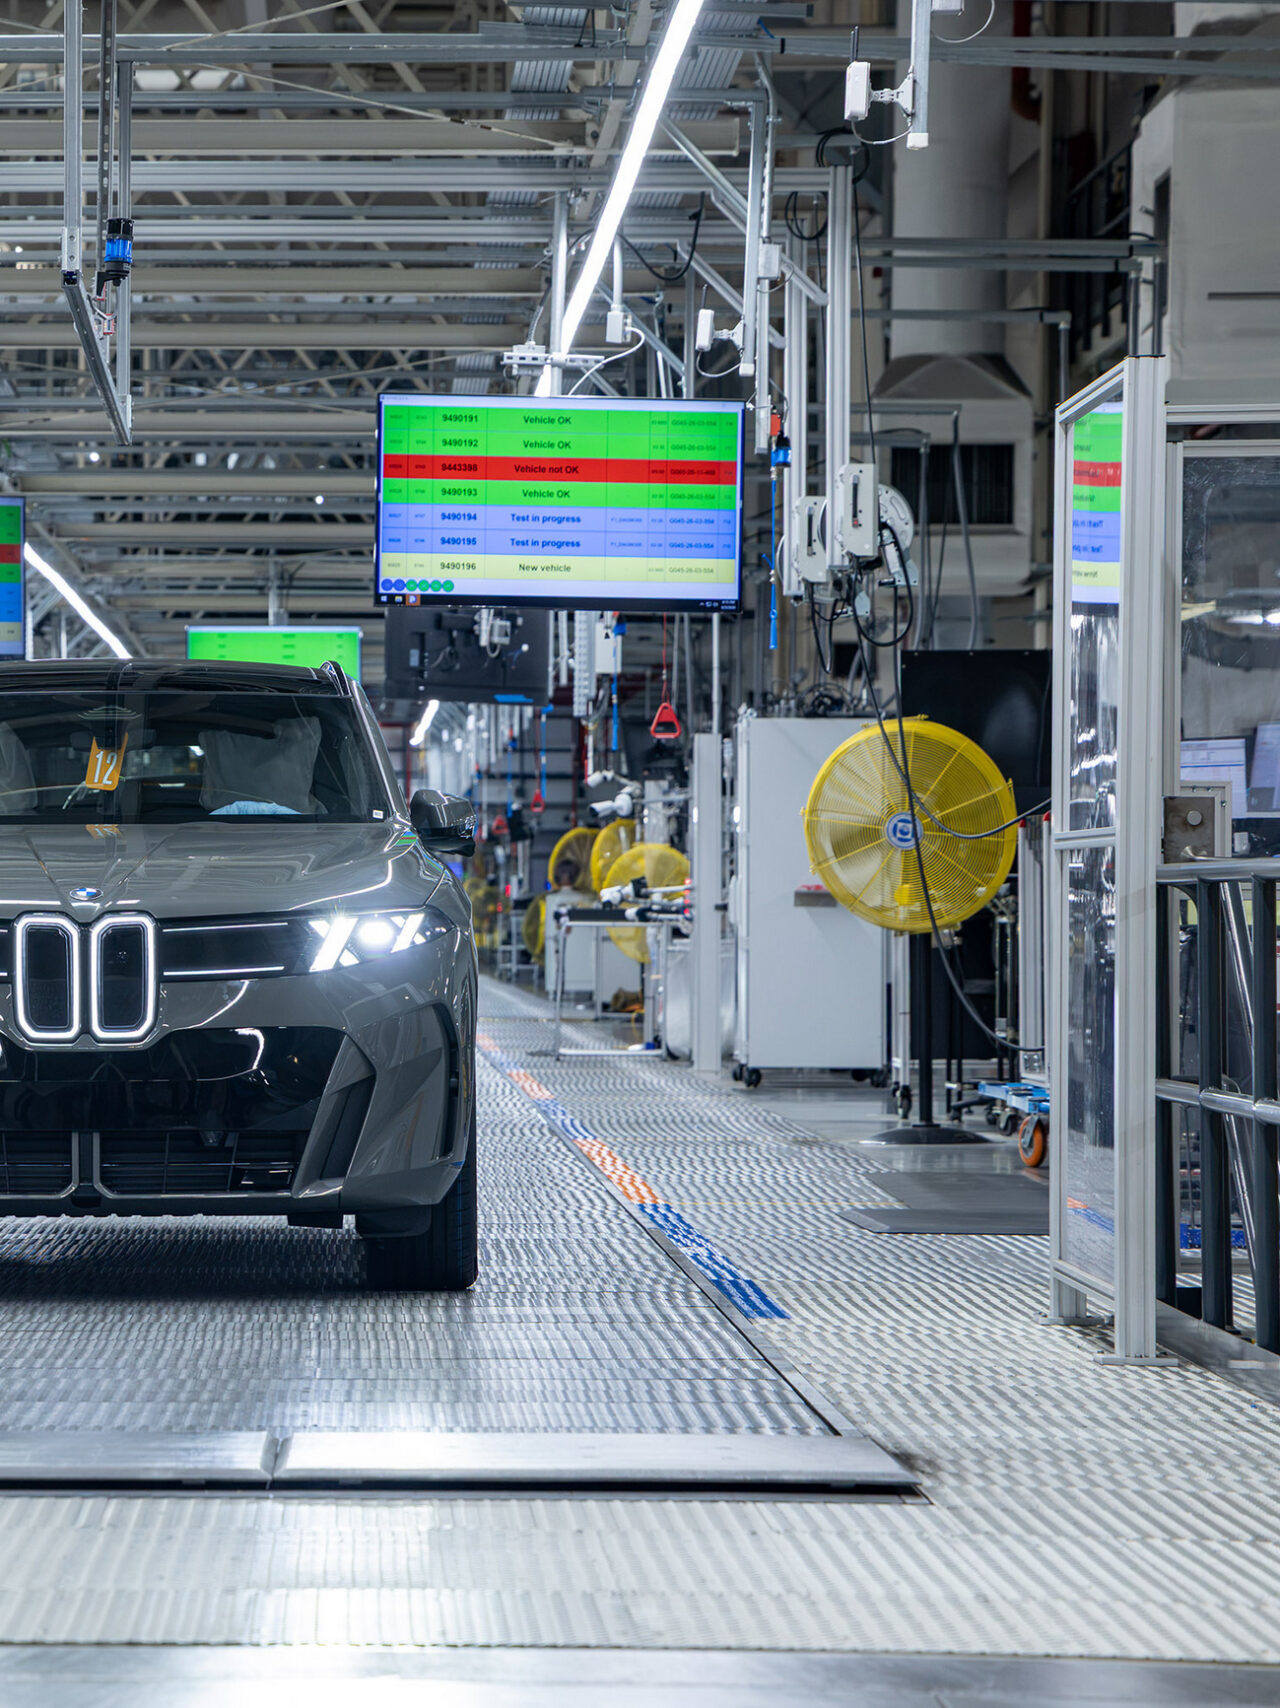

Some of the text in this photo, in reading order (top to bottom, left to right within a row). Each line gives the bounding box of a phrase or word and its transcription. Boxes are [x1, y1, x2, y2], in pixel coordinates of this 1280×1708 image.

[442, 414, 478, 422] 9490191
[523, 415, 555, 424] Vehicle
[557, 416, 572, 425] OK
[441, 439, 478, 447] 9490192
[523, 440, 555, 448] Vehicle
[557, 440, 571, 449] OK
[514, 464, 546, 473] Vehicle
[549, 465, 563, 473] not
[565, 465, 579, 474] OK
[441, 487, 478, 496] 9490193
[522, 489, 554, 498] Vehicle
[556, 490, 570, 498] OK
[440, 512, 477, 521] 9490194
[510, 513, 529, 522] Test
[531, 514, 540, 522] in
[542, 515, 581, 524] progress
[440, 536, 477, 545] 9490195
[510, 538, 529, 546] Test
[531, 538, 539, 546] in
[541, 540, 581, 549] progress
[440, 561, 476, 570] 9490196
[518, 564, 538, 572] New
[540, 564, 572, 572] vehicle
[94, 750, 118, 785] 12
